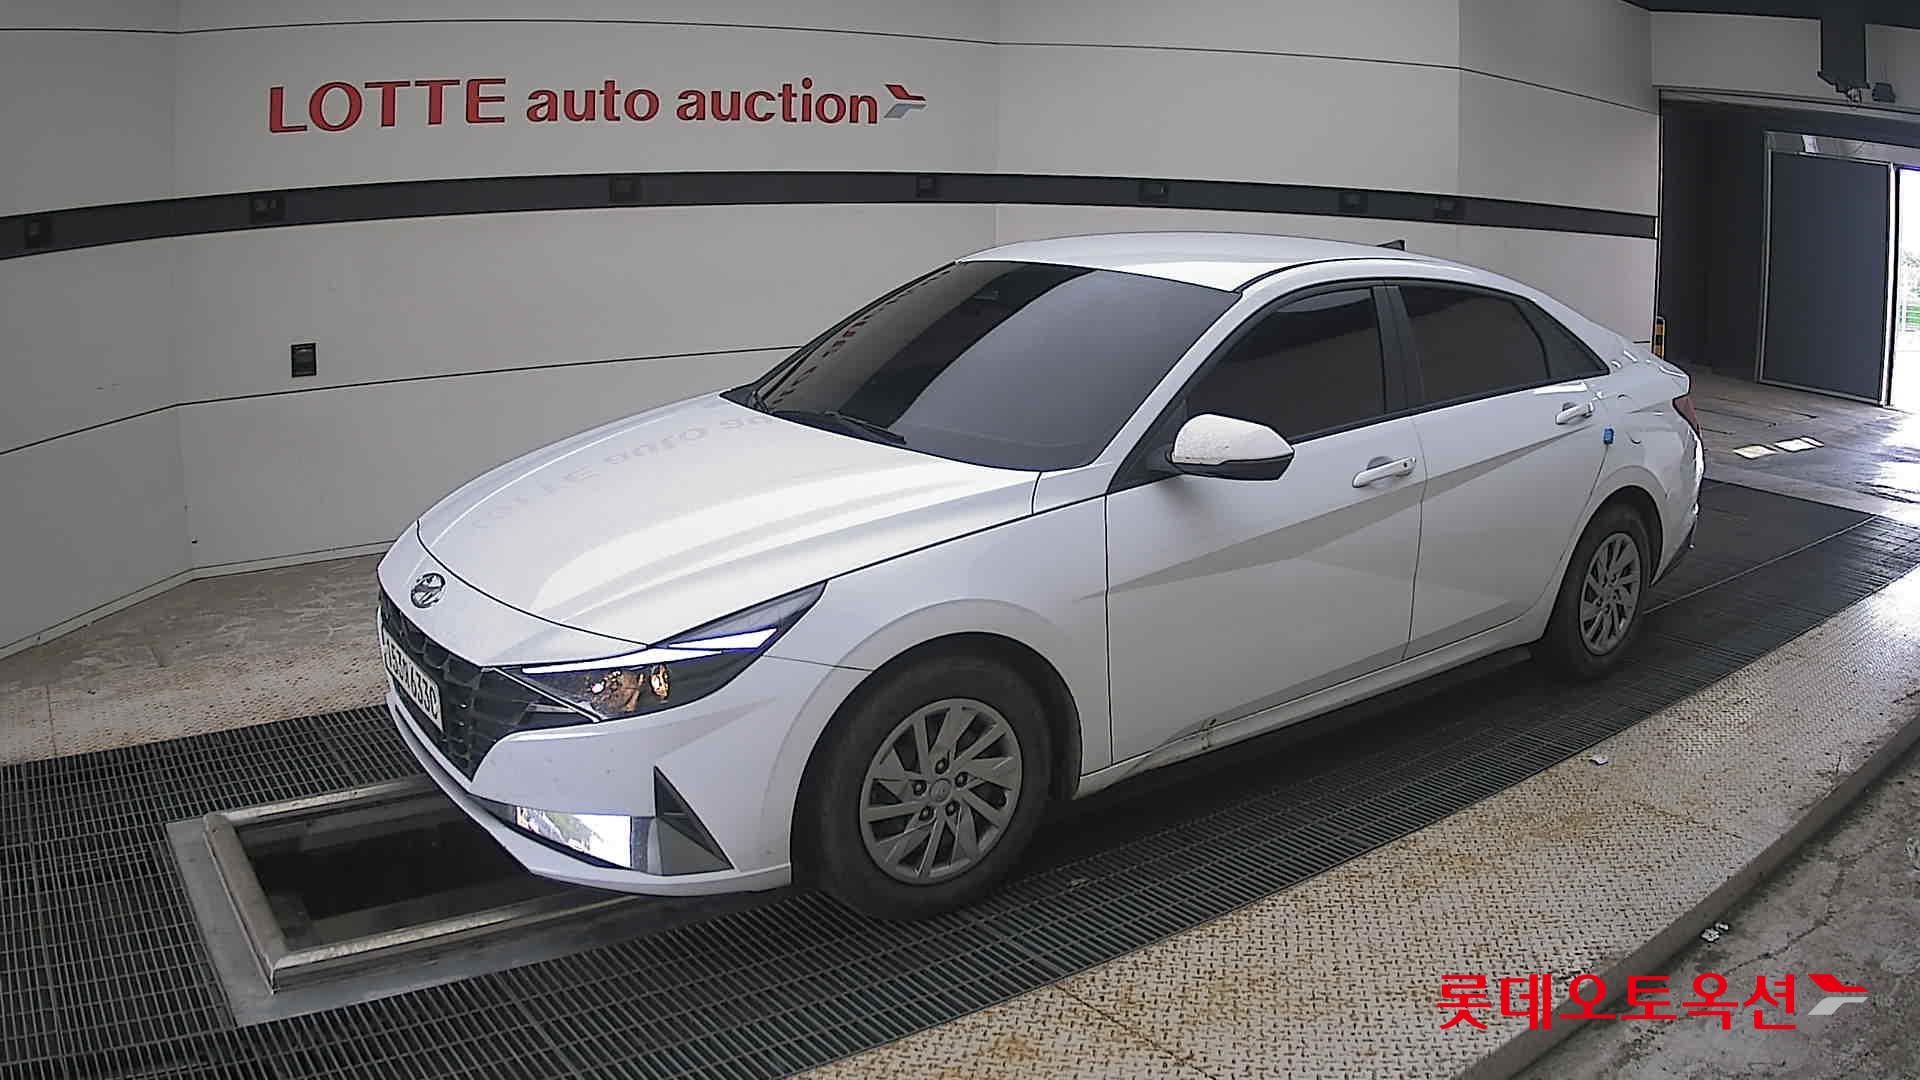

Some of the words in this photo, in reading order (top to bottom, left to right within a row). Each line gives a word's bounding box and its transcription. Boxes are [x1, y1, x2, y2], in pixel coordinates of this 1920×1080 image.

[269, 78, 506, 133] LOTTE
[526, 79, 660, 125] auto
[676, 77, 878, 125] auction
